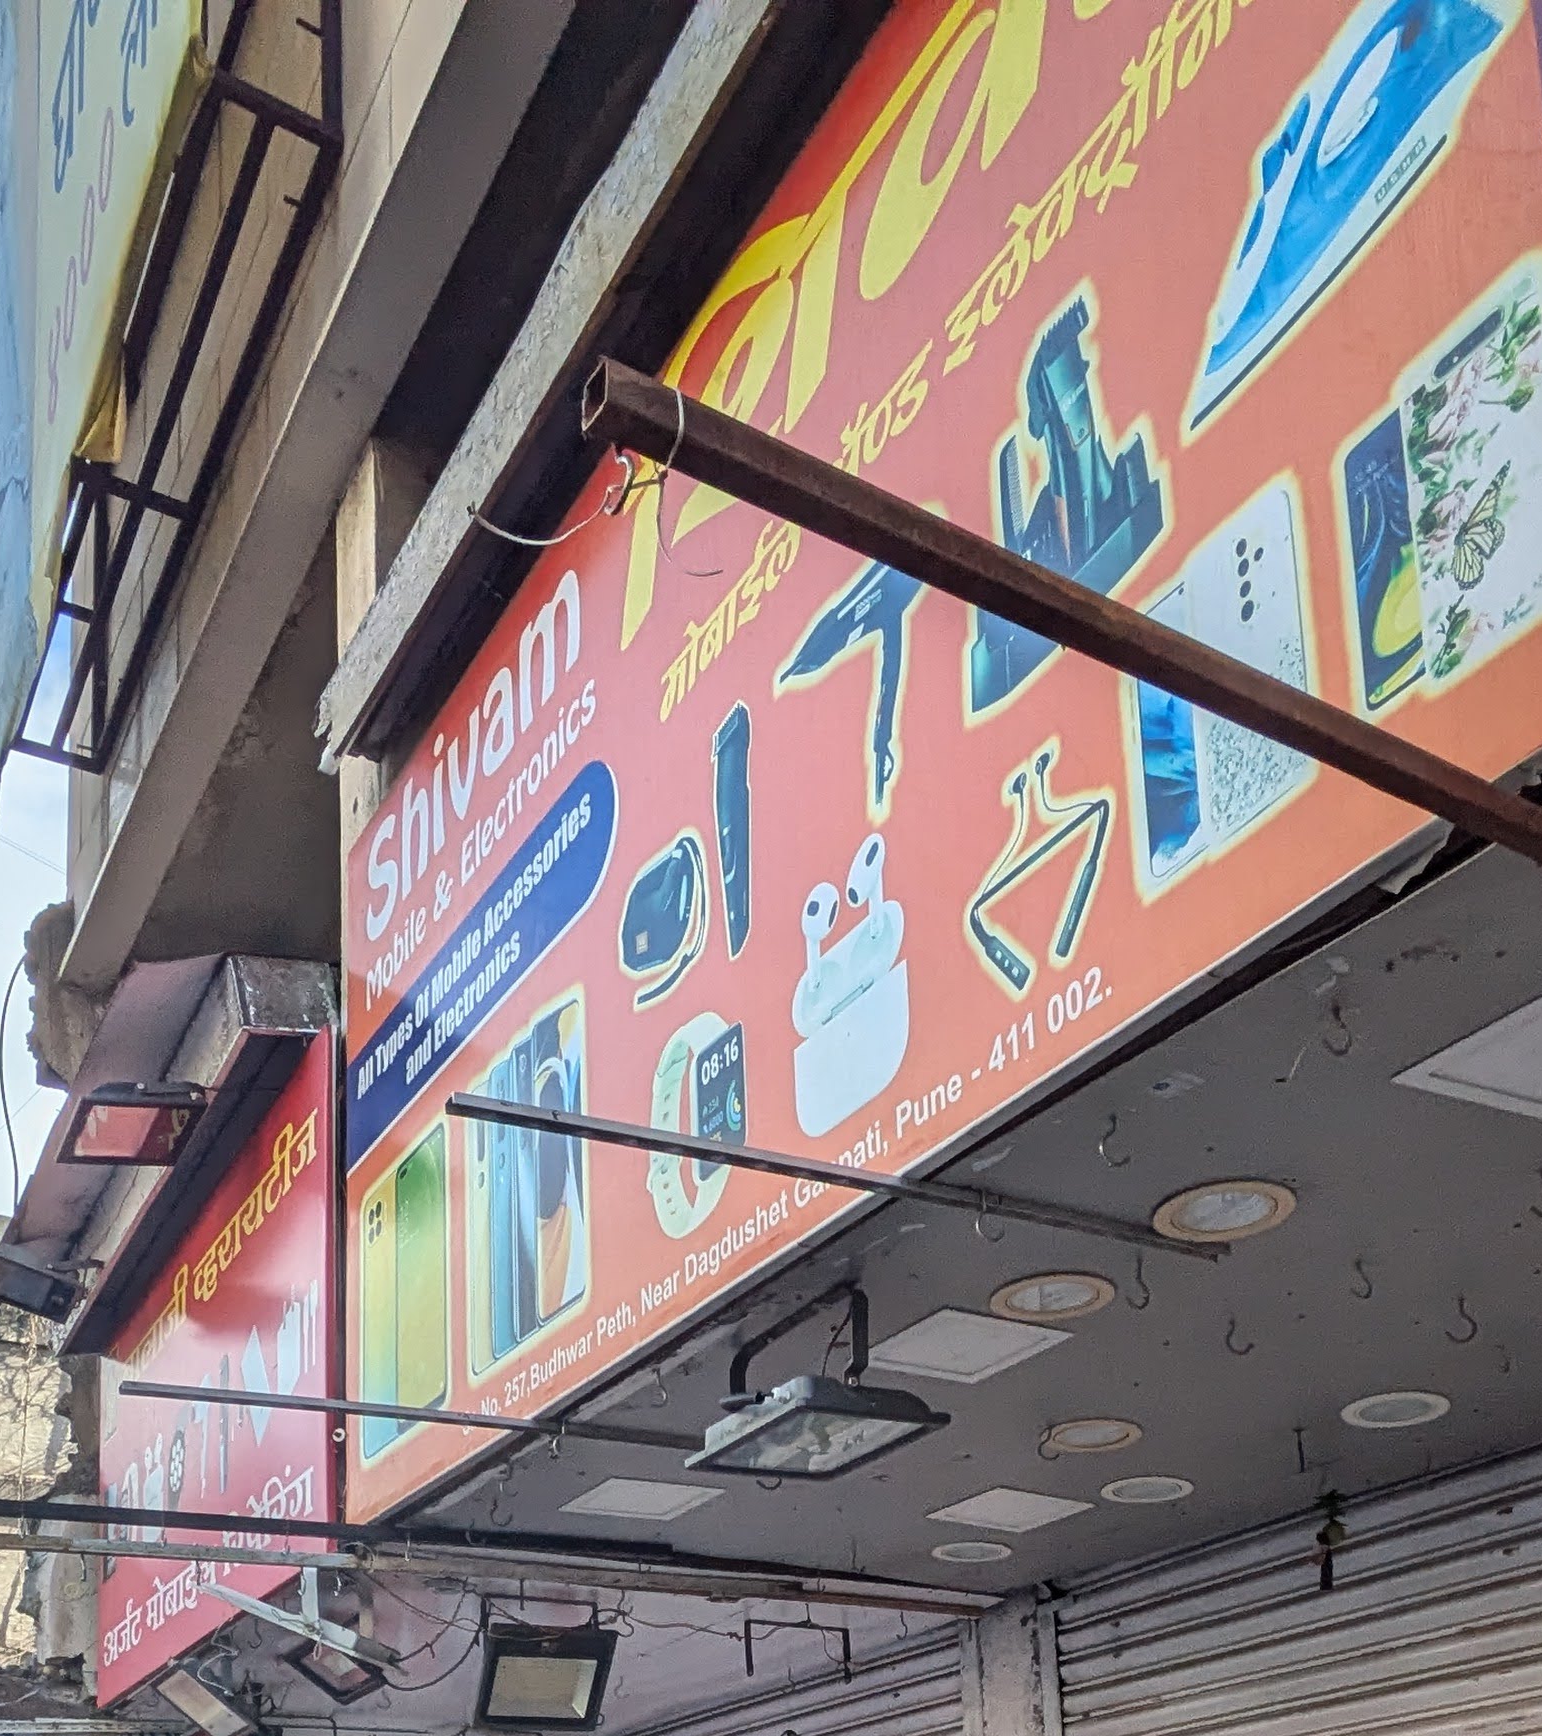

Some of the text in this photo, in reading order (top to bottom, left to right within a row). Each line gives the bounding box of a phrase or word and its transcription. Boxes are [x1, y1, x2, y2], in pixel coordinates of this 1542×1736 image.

[619, 0, 1111, 650] शिव
[365, 568, 581, 942] Shivam
[365, 678, 597, 1012] Mobile & Electronics
[357, 792, 592, 1100] All Types Of Mobile Accessories
[405, 930, 521, 1086] and Electronics
[701, 1035, 740, 1086] 08:16
[596, 1301, 637, 1346] Peth,
[640, 1269, 680, 1317] Near
[684, 1189, 789, 1286] Dagdushet
[895, 1074, 963, 1140] Pune
[988, 1011, 1035, 1072] 411
[1046, 966, 1113, 1034] 002.
